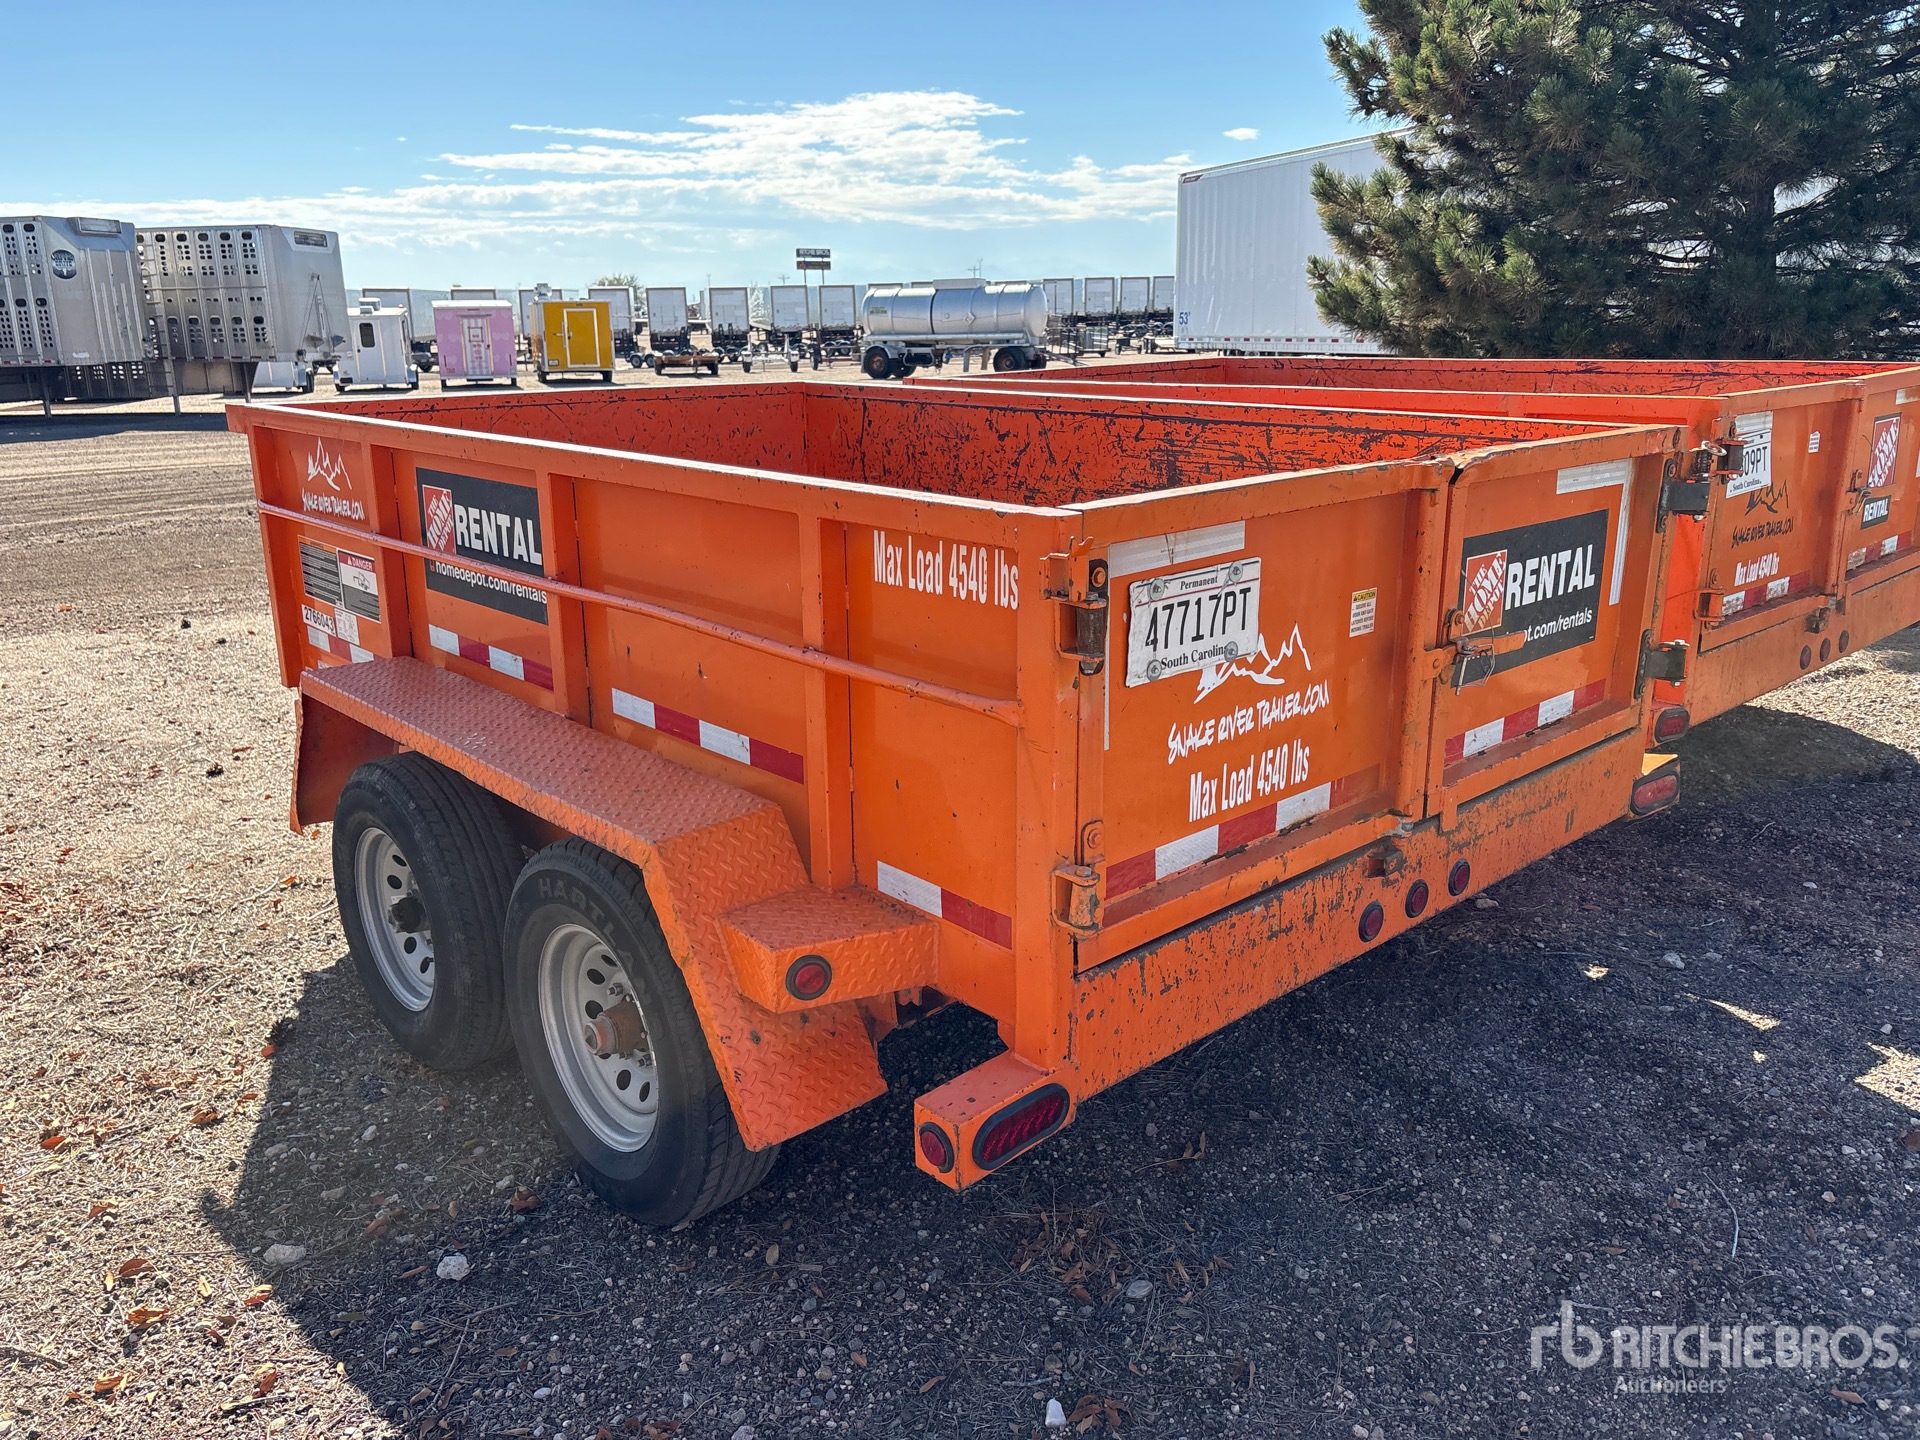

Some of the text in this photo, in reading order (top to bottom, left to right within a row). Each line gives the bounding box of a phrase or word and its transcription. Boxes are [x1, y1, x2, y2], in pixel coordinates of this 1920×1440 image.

[427, 494, 439, 518] THE
[1732, 477, 1760, 492] South Carolina
[427, 489, 452, 549] HOME
[454, 504, 543, 566] RENTAL
[1863, 498, 1888, 523] RENTAL
[351, 556, 373, 572] DANGER
[873, 529, 1019, 610] Max Load 4540 lbs
[1180, 576, 1218, 590] Permanent
[1469, 564, 1487, 596] THE
[1505, 544, 1596, 611] RENTAL
[1357, 591, 1376, 600] CAUTION
[1464, 551, 1506, 633] HOME
[1477, 579, 1504, 630] DEPOT
[1145, 587, 1251, 653] 47717PT
[1161, 652, 1189, 671] South
[1167, 679, 1329, 765] SNAKE RIVER TRAILER.COM
[1189, 738, 1310, 823] Max Load 4540 lbs
